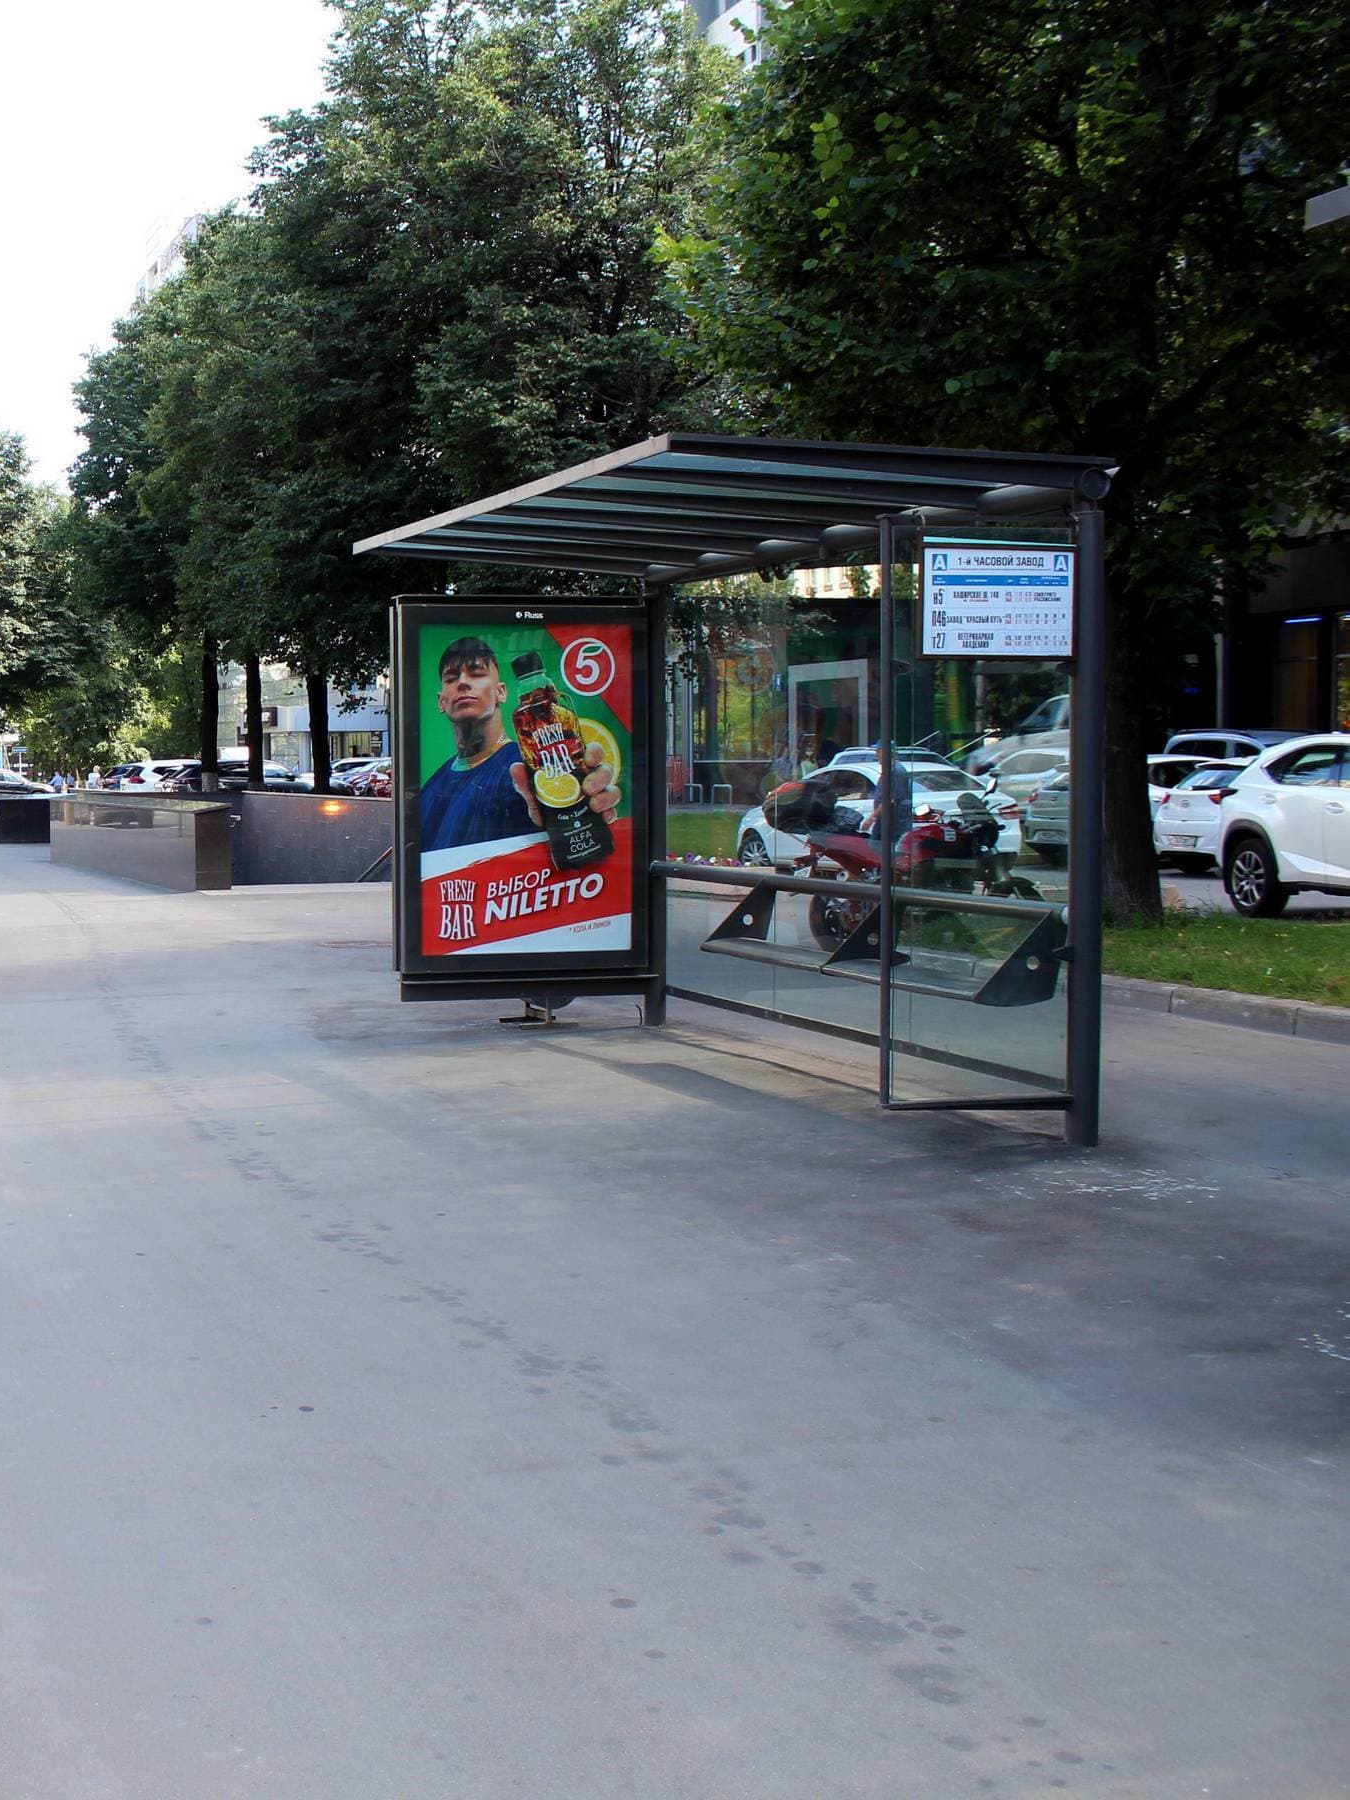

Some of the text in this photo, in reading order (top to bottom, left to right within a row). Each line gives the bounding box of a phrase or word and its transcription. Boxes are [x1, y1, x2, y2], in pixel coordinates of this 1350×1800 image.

[974, 555, 1013, 567] ЧАСОВОЙ
[1016, 557, 1044, 568] ЗАВОД
[532, 722, 565, 749] FRESH
[539, 743, 575, 779] BAR
[569, 830, 592, 844] ALFA
[570, 838, 595, 853] COLA
[439, 878, 476, 902] FRESH
[487, 868, 551, 899] ВЫБОР
[483, 873, 604, 925] NILETTO
[438, 903, 477, 941] BAR
